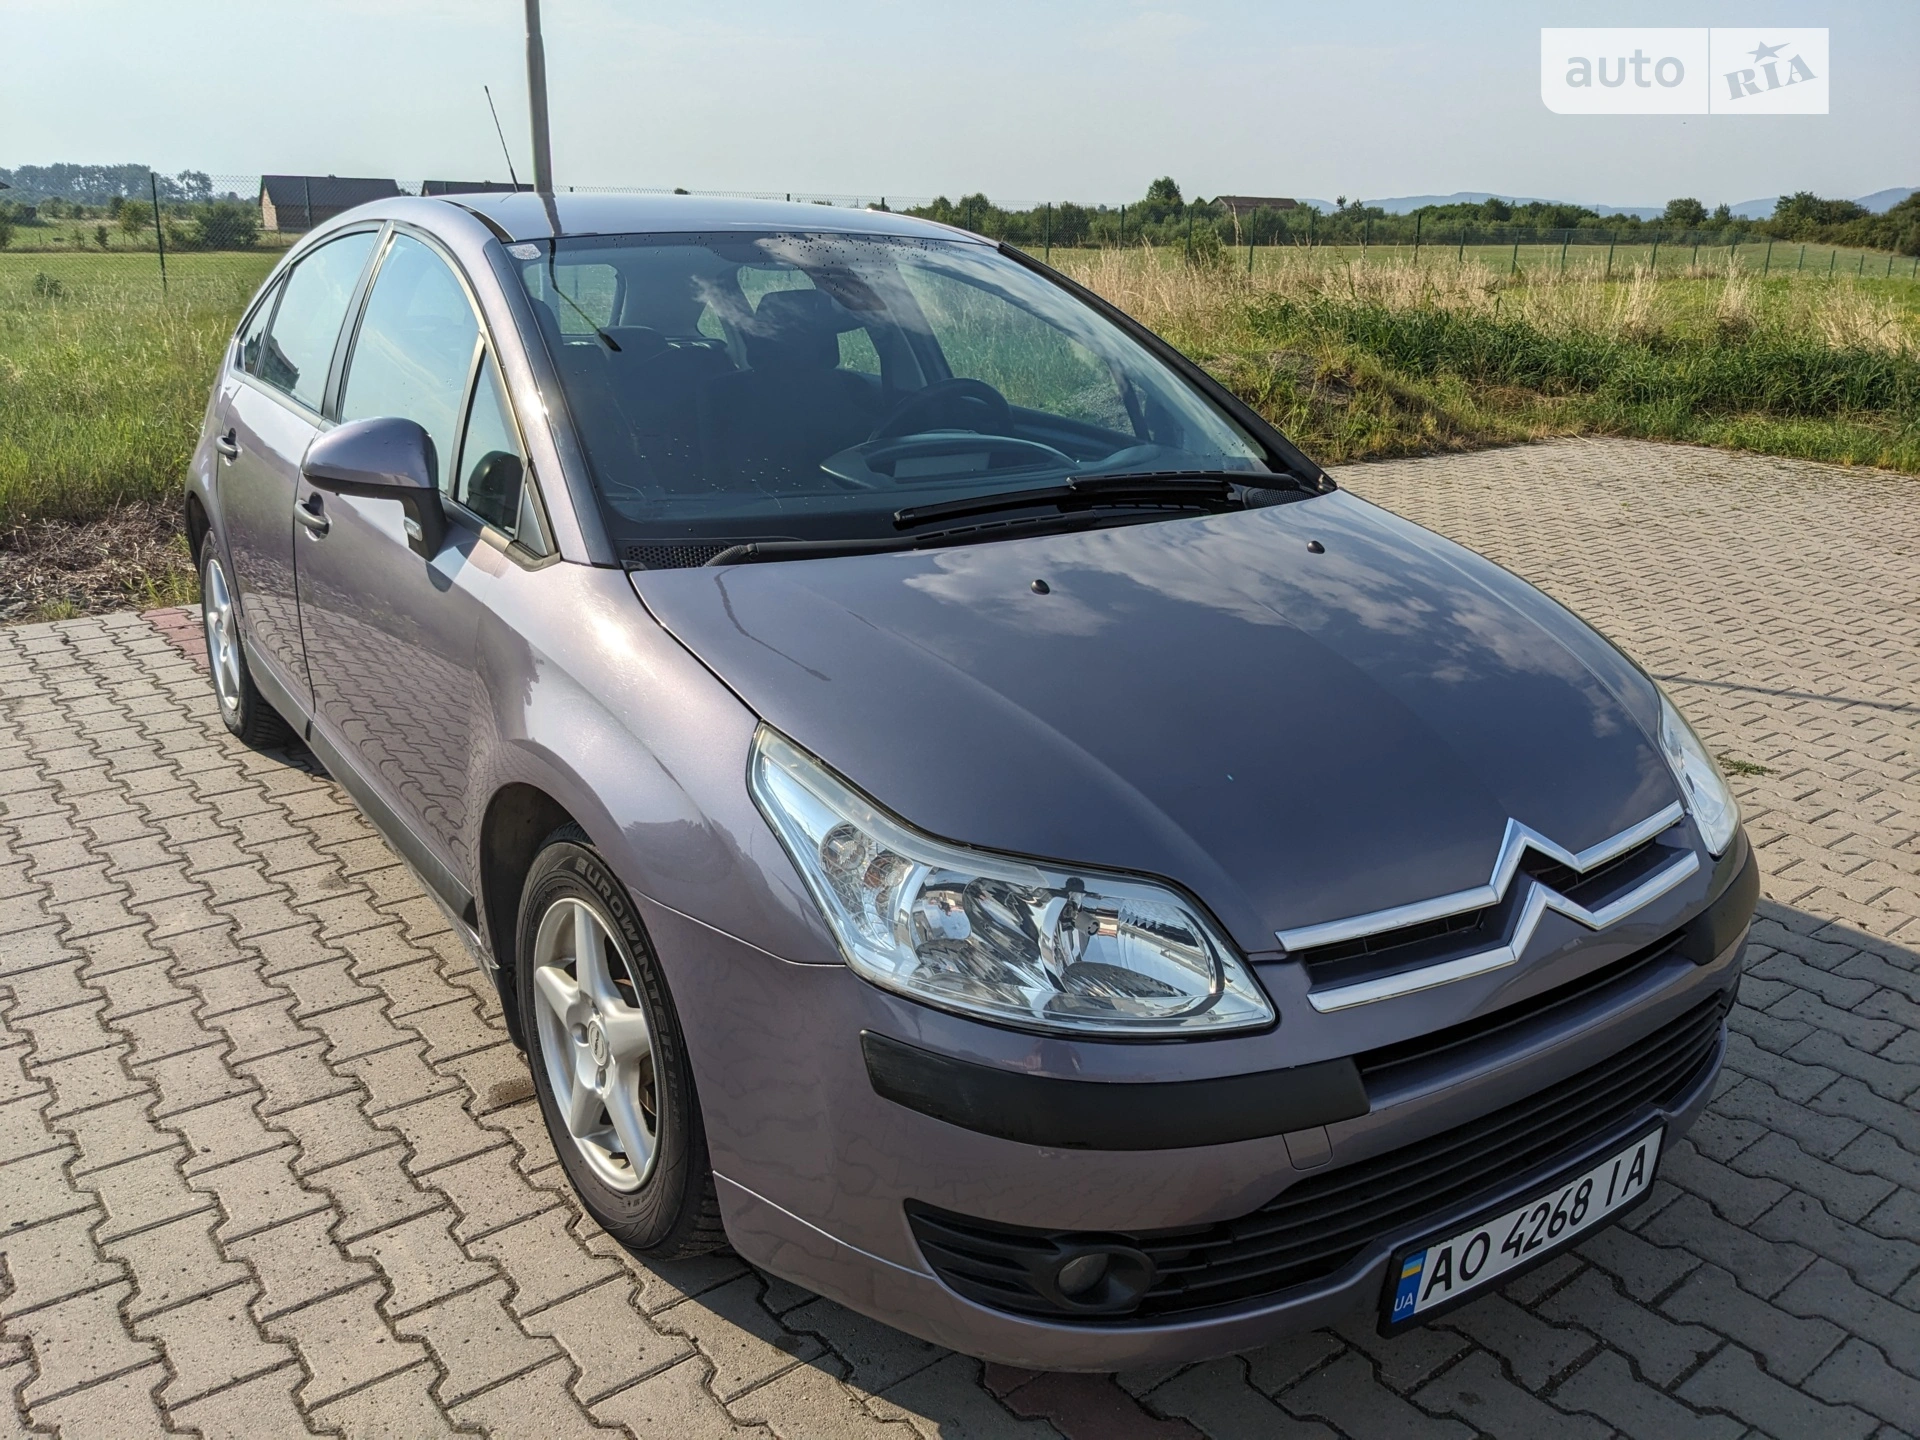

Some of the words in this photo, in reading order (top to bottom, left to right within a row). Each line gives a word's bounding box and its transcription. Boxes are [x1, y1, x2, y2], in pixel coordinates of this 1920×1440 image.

[574, 856, 674, 1062] EUROWINTER
[1393, 1292, 1414, 1312] UA
[1421, 1231, 1491, 1302] AO
[1501, 1177, 1593, 1259] 4268
[1605, 1143, 1646, 1207] IA
